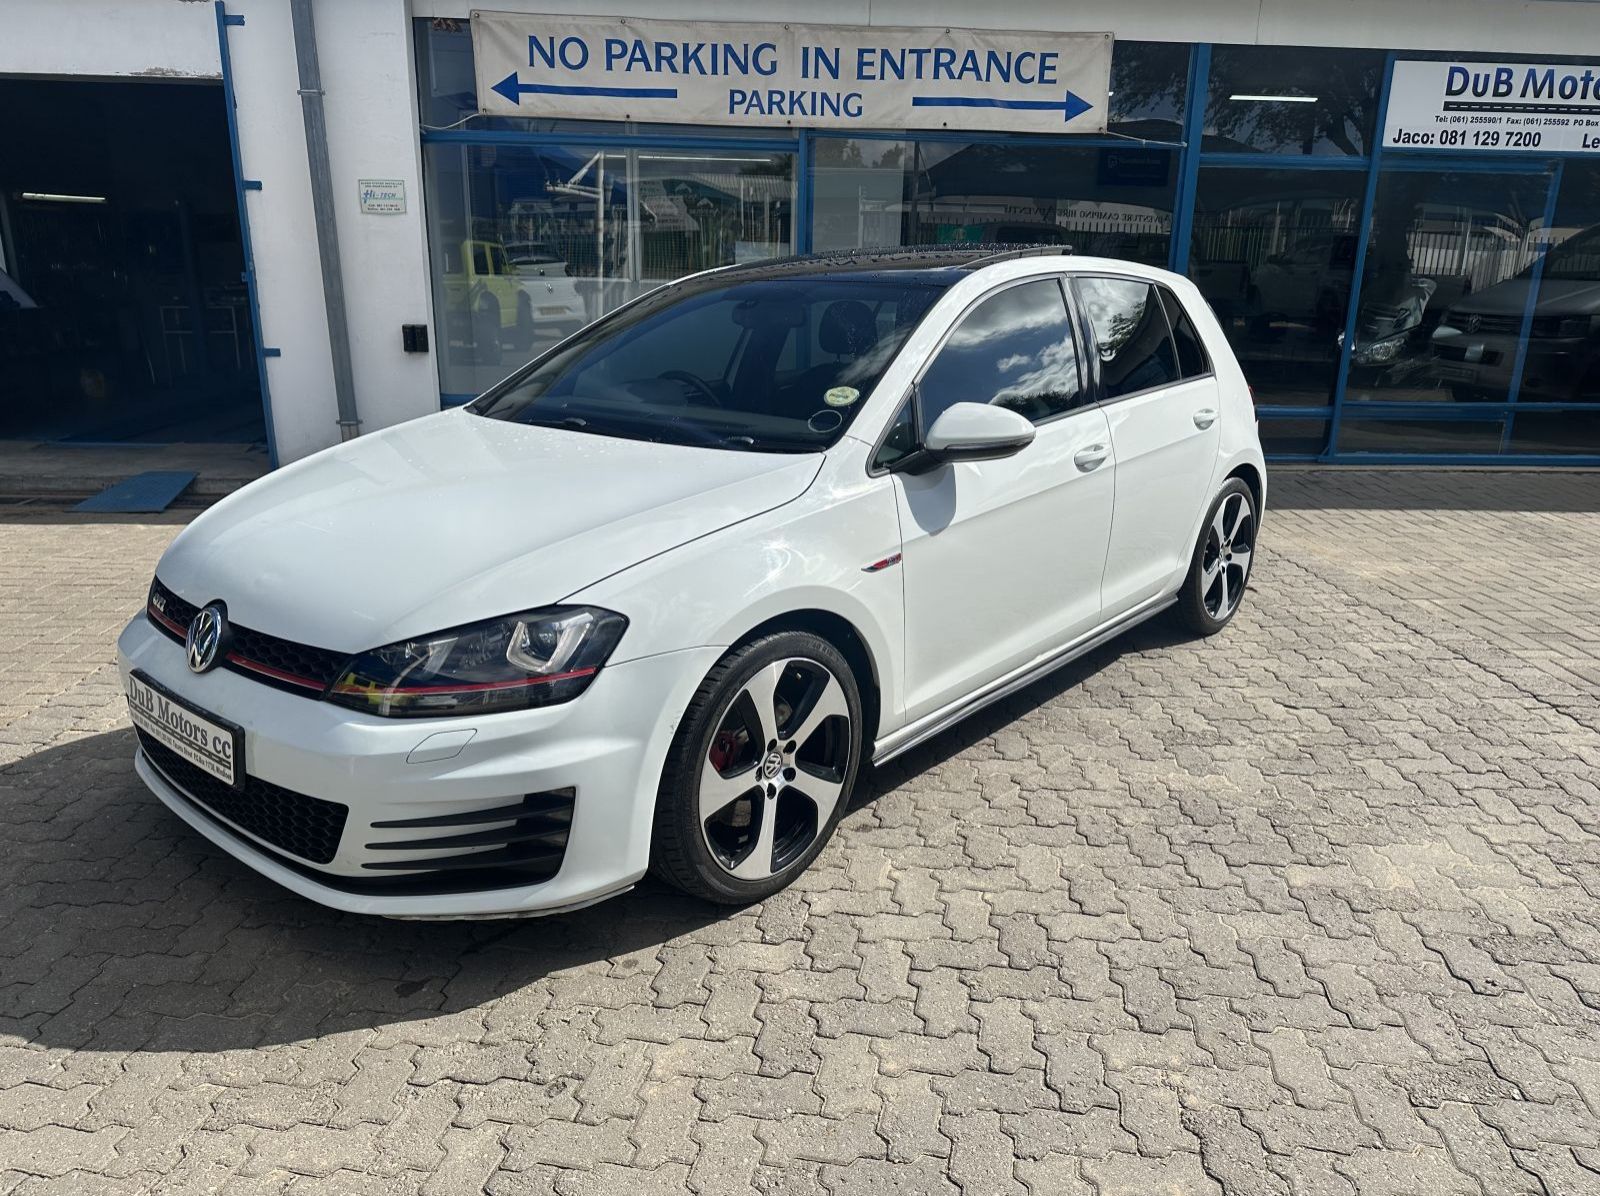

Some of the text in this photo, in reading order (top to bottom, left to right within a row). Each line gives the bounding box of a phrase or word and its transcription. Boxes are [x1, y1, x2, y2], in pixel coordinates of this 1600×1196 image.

[528, 35, 1059, 84] NO PARKING IN ENTRANCE
[1445, 66, 1513, 98] DuB
[729, 89, 863, 118] PARKING
[1434, 115, 1449, 123] Tel:
[1449, 115, 1469, 124] (061)
[1470, 116, 1502, 124] 255590/1
[1506, 117, 1522, 125] Fax:
[1523, 117, 1542, 126] (061)
[1543, 118, 1570, 126] 255592
[1585, 119, 1599, 127] Box
[1393, 128, 1542, 147] Jaco: 081 129 7200
[129, 675, 154, 713] DuB
[157, 696, 208, 747] Motors
[212, 735, 231, 759] cc
